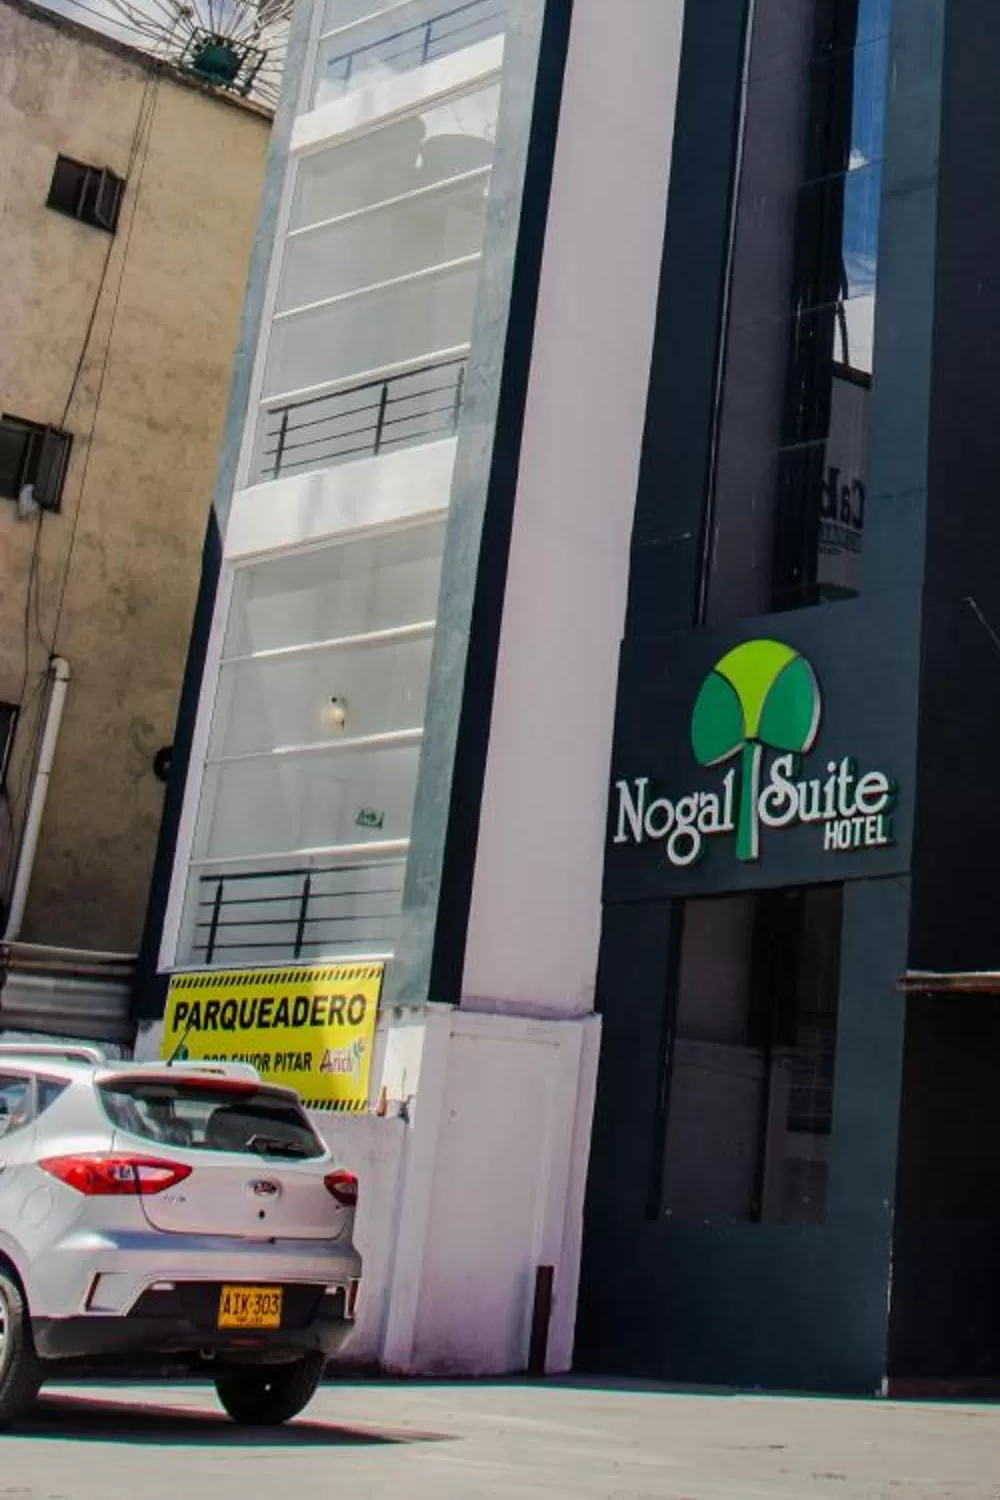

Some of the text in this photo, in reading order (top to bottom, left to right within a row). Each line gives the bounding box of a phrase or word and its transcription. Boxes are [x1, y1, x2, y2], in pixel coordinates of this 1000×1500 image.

[613, 754, 889, 866] Nogal Suite
[824, 815, 887, 850] HOTEL
[172, 993, 367, 1032] PARQUEADERO
[273, 1051, 312, 1073] PITAR
